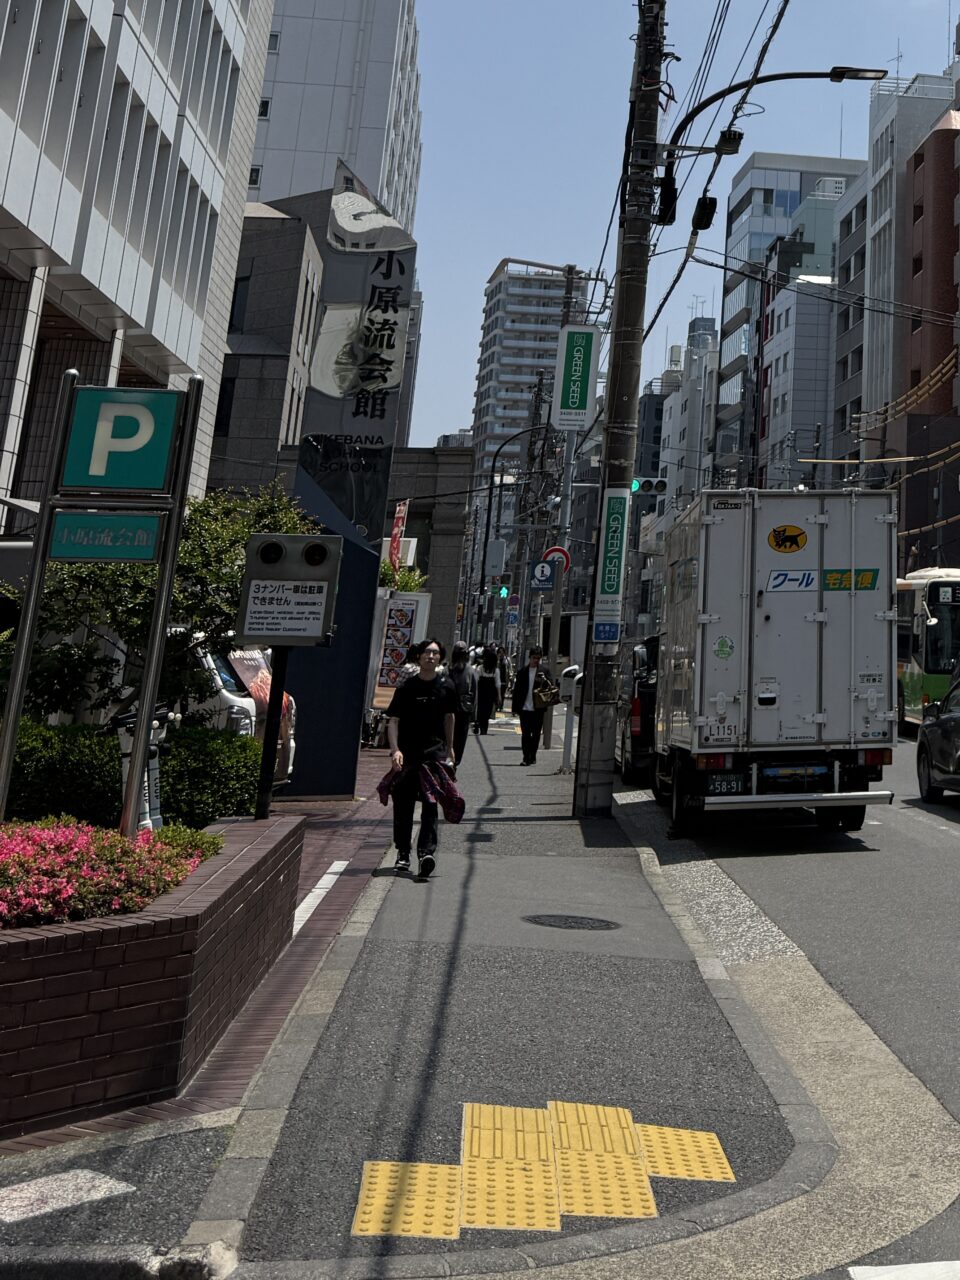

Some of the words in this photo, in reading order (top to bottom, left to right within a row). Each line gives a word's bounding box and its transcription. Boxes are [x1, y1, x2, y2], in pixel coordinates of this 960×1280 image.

[352, 250, 406, 419] 小原流会館
[572, 346, 584, 380] GREEN
[569, 381, 581, 407] SEED
[88, 402, 155, 476] P
[319, 462, 379, 473] SCHOOL
[59, 527, 153, 546] 小原流会館
[607, 513, 622, 557] GREEN
[605, 559, 619, 592] SEED
[772, 573, 814, 590] クール
[826, 571, 874, 589] 宅急便
[251, 596, 291, 606] できません
[709, 724, 738, 737] L1151
[715, 781, 742, 792] 58-91
